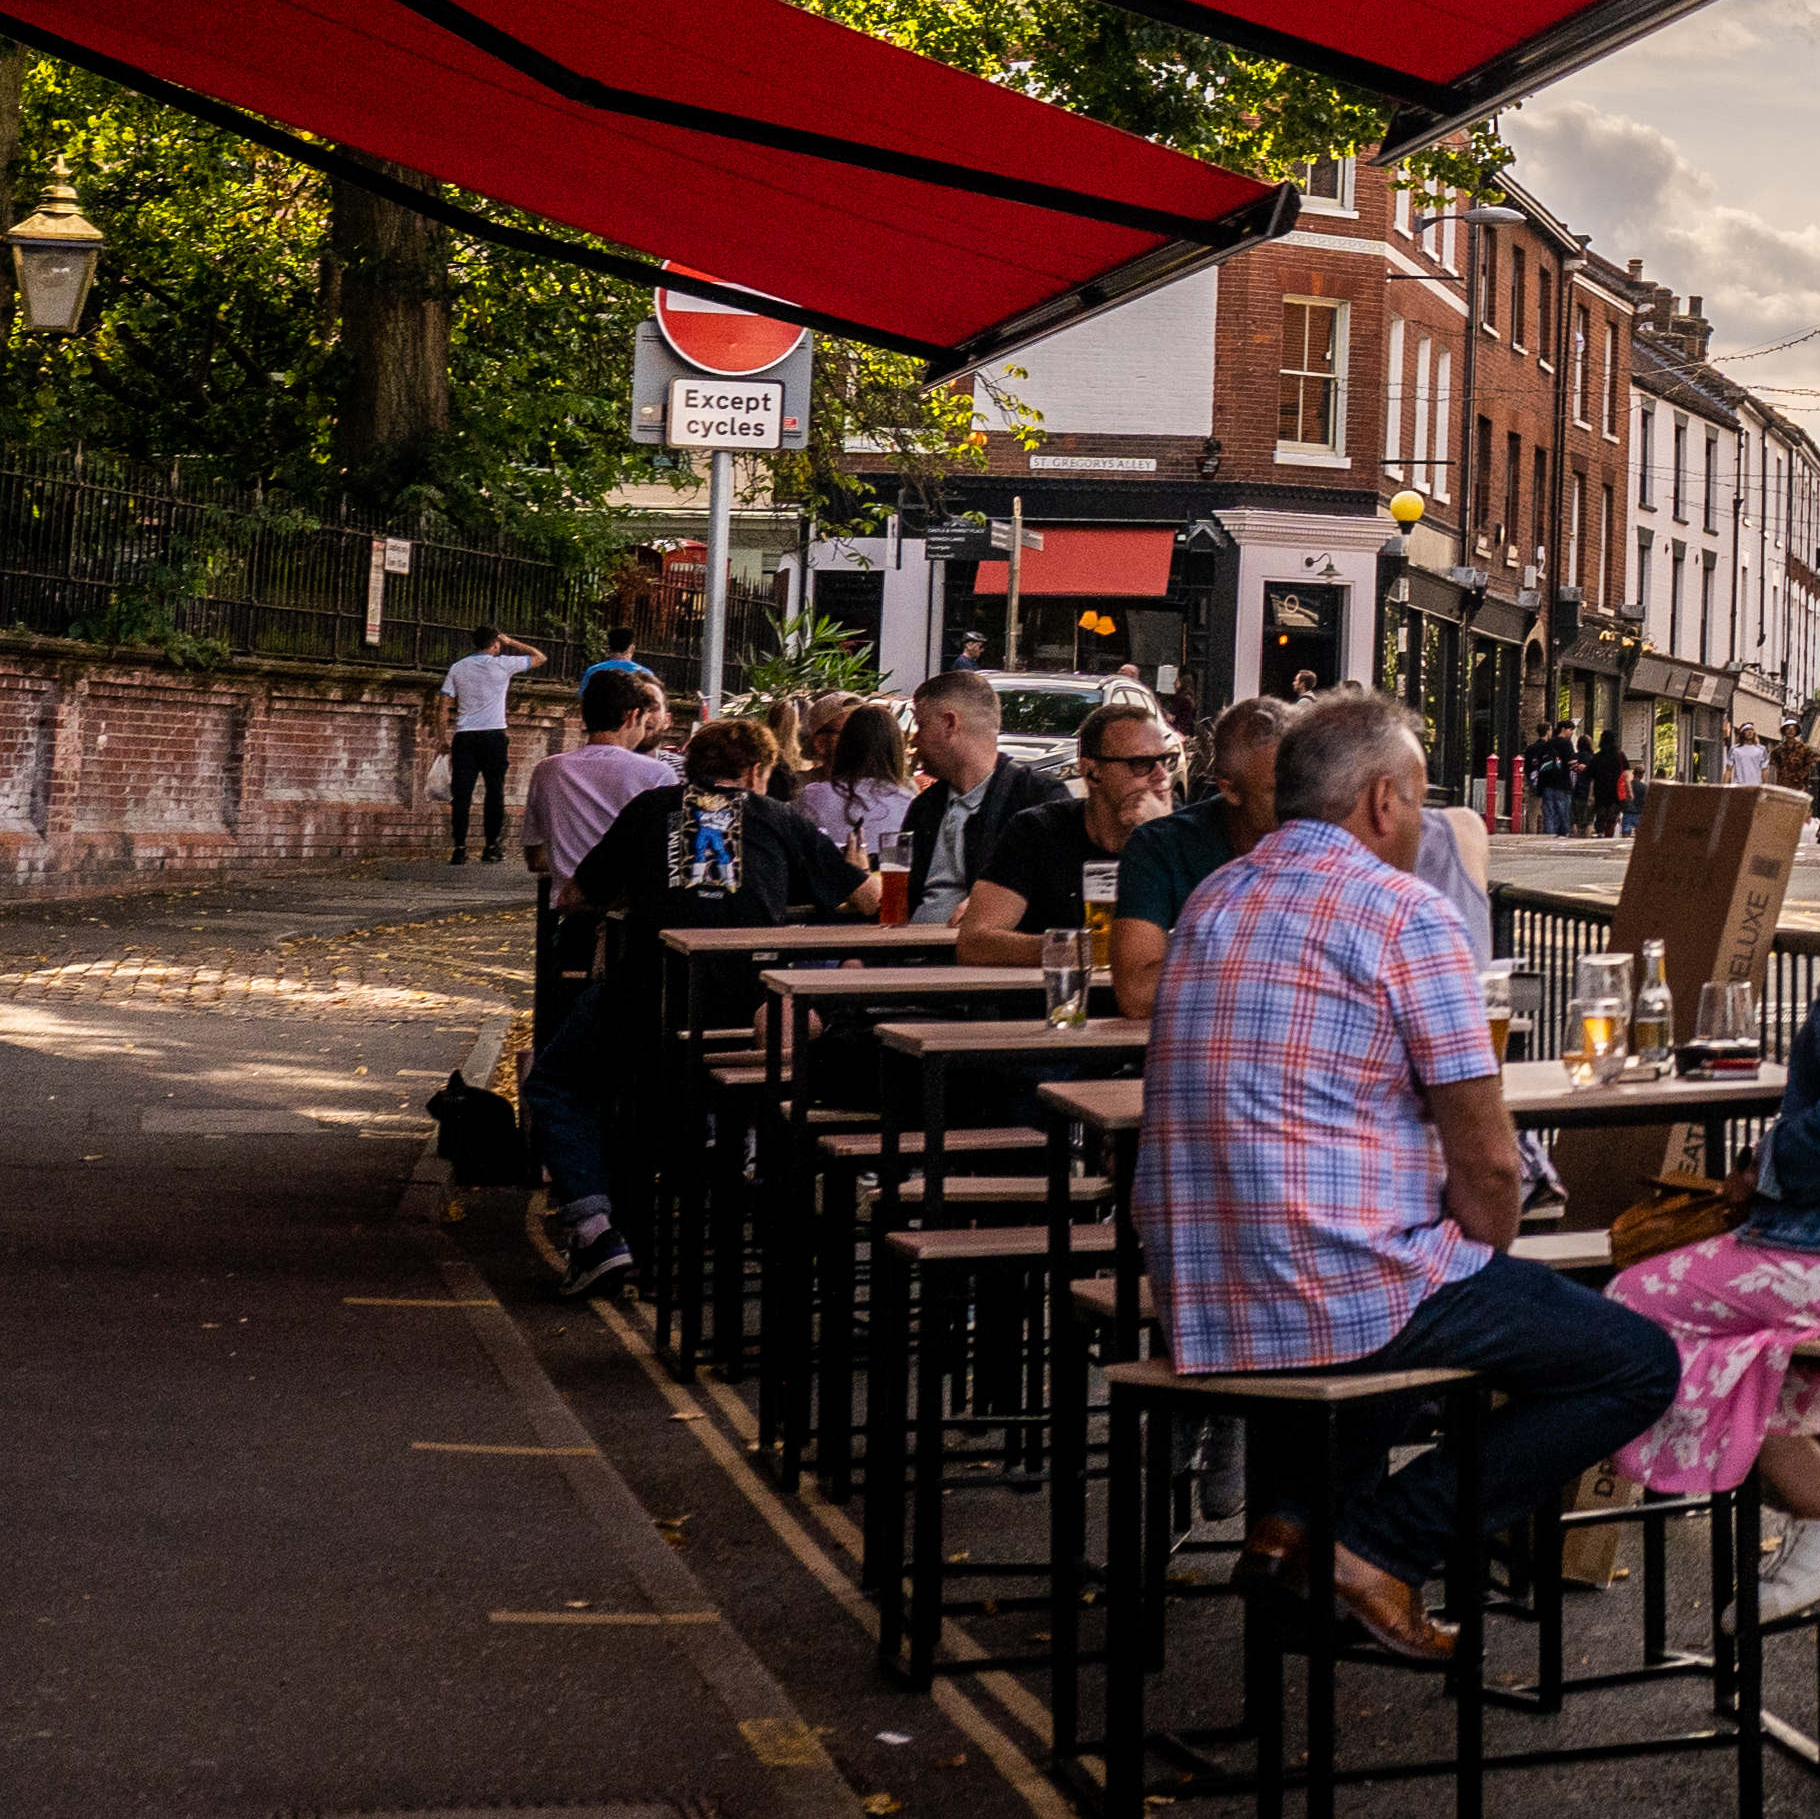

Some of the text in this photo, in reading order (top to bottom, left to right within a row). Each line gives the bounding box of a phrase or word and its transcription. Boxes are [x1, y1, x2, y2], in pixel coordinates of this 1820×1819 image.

[685, 389, 772, 414] Except
[687, 417, 765, 439] cycles
[1117, 460, 1152, 470] ALLEY
